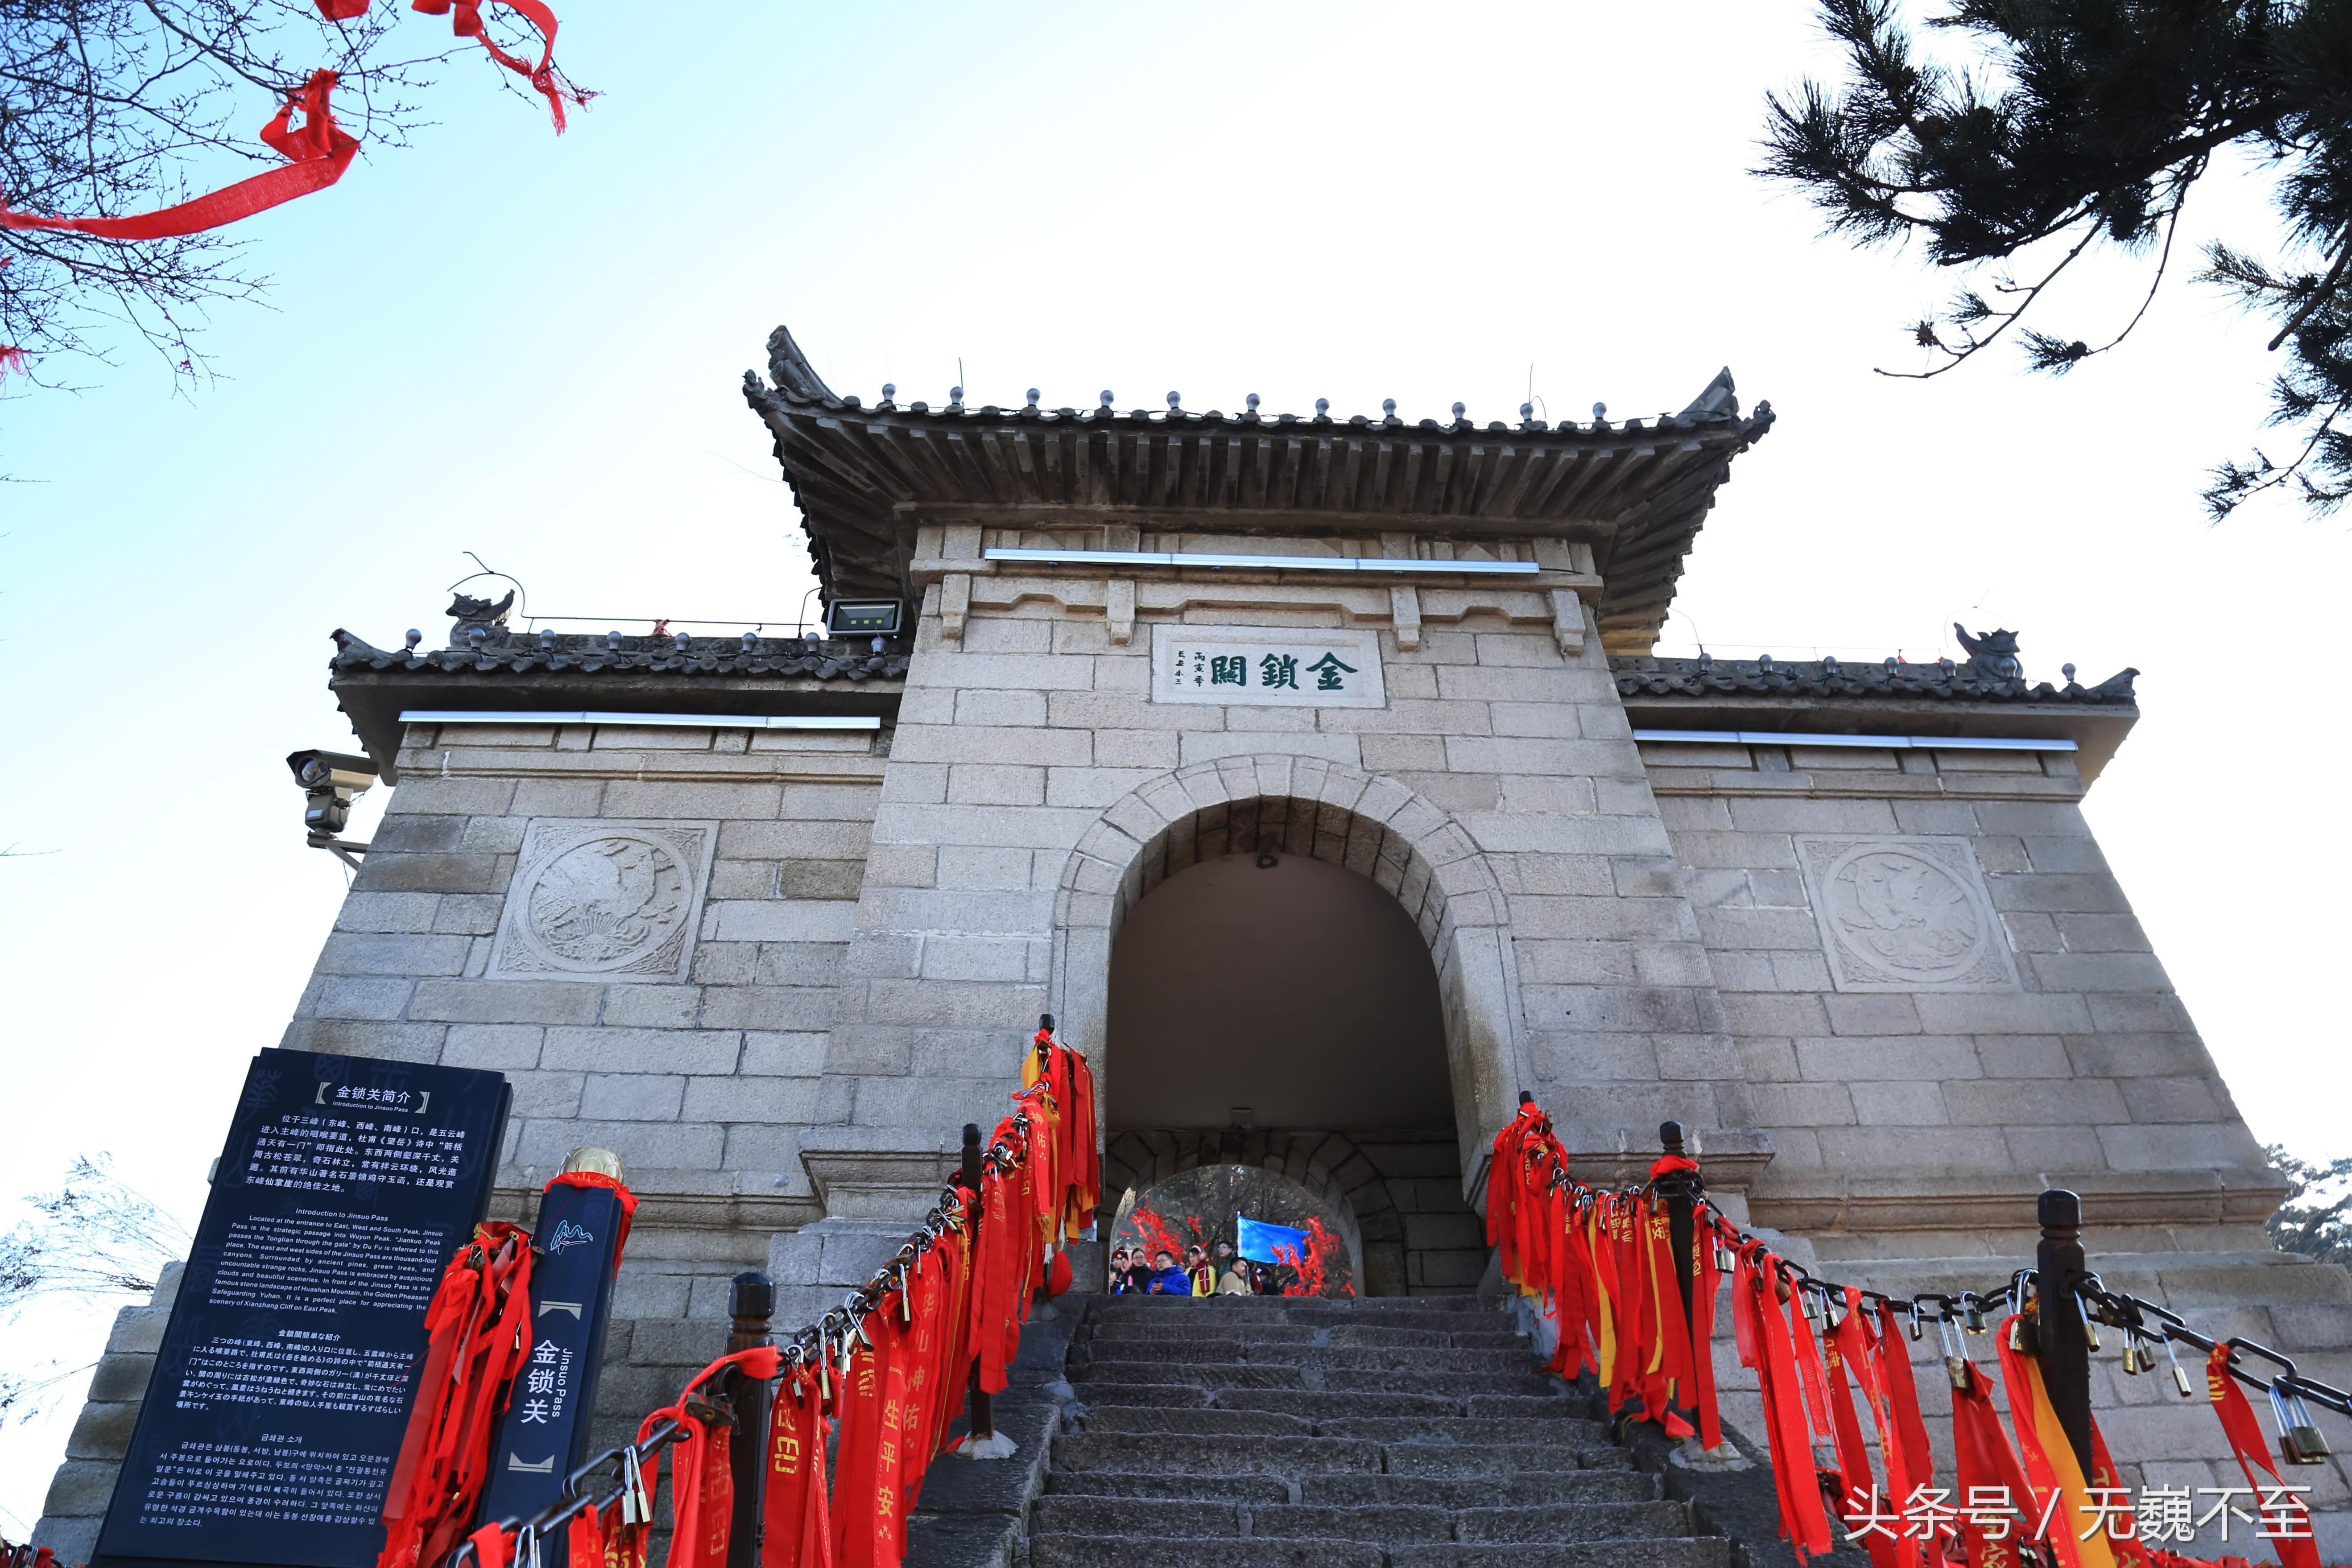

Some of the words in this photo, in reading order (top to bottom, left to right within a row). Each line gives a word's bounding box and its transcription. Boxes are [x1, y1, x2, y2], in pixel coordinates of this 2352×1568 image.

[336, 1085, 411, 1103] 金锁关简介
[295, 1208, 337, 1217] Introduction
[260, 1254, 300, 1262] Surrounded
[393, 1255, 437, 1263] thousand-foot
[259, 1283, 292, 1291] landscape
[331, 1288, 361, 1296] Mountain,
[212, 1288, 256, 1298] Safeguarding
[373, 1302, 412, 1310] appreciating
[244, 1300, 278, 1309] Xianzhang
[558, 1349, 572, 1385] Jinsuo
[521, 1340, 560, 1424] 金锁关
[175, 1400, 208, 1410] 場所です。
[552, 1389, 566, 1417] Pass
[877, 1366, 902, 1518] 一生平安
